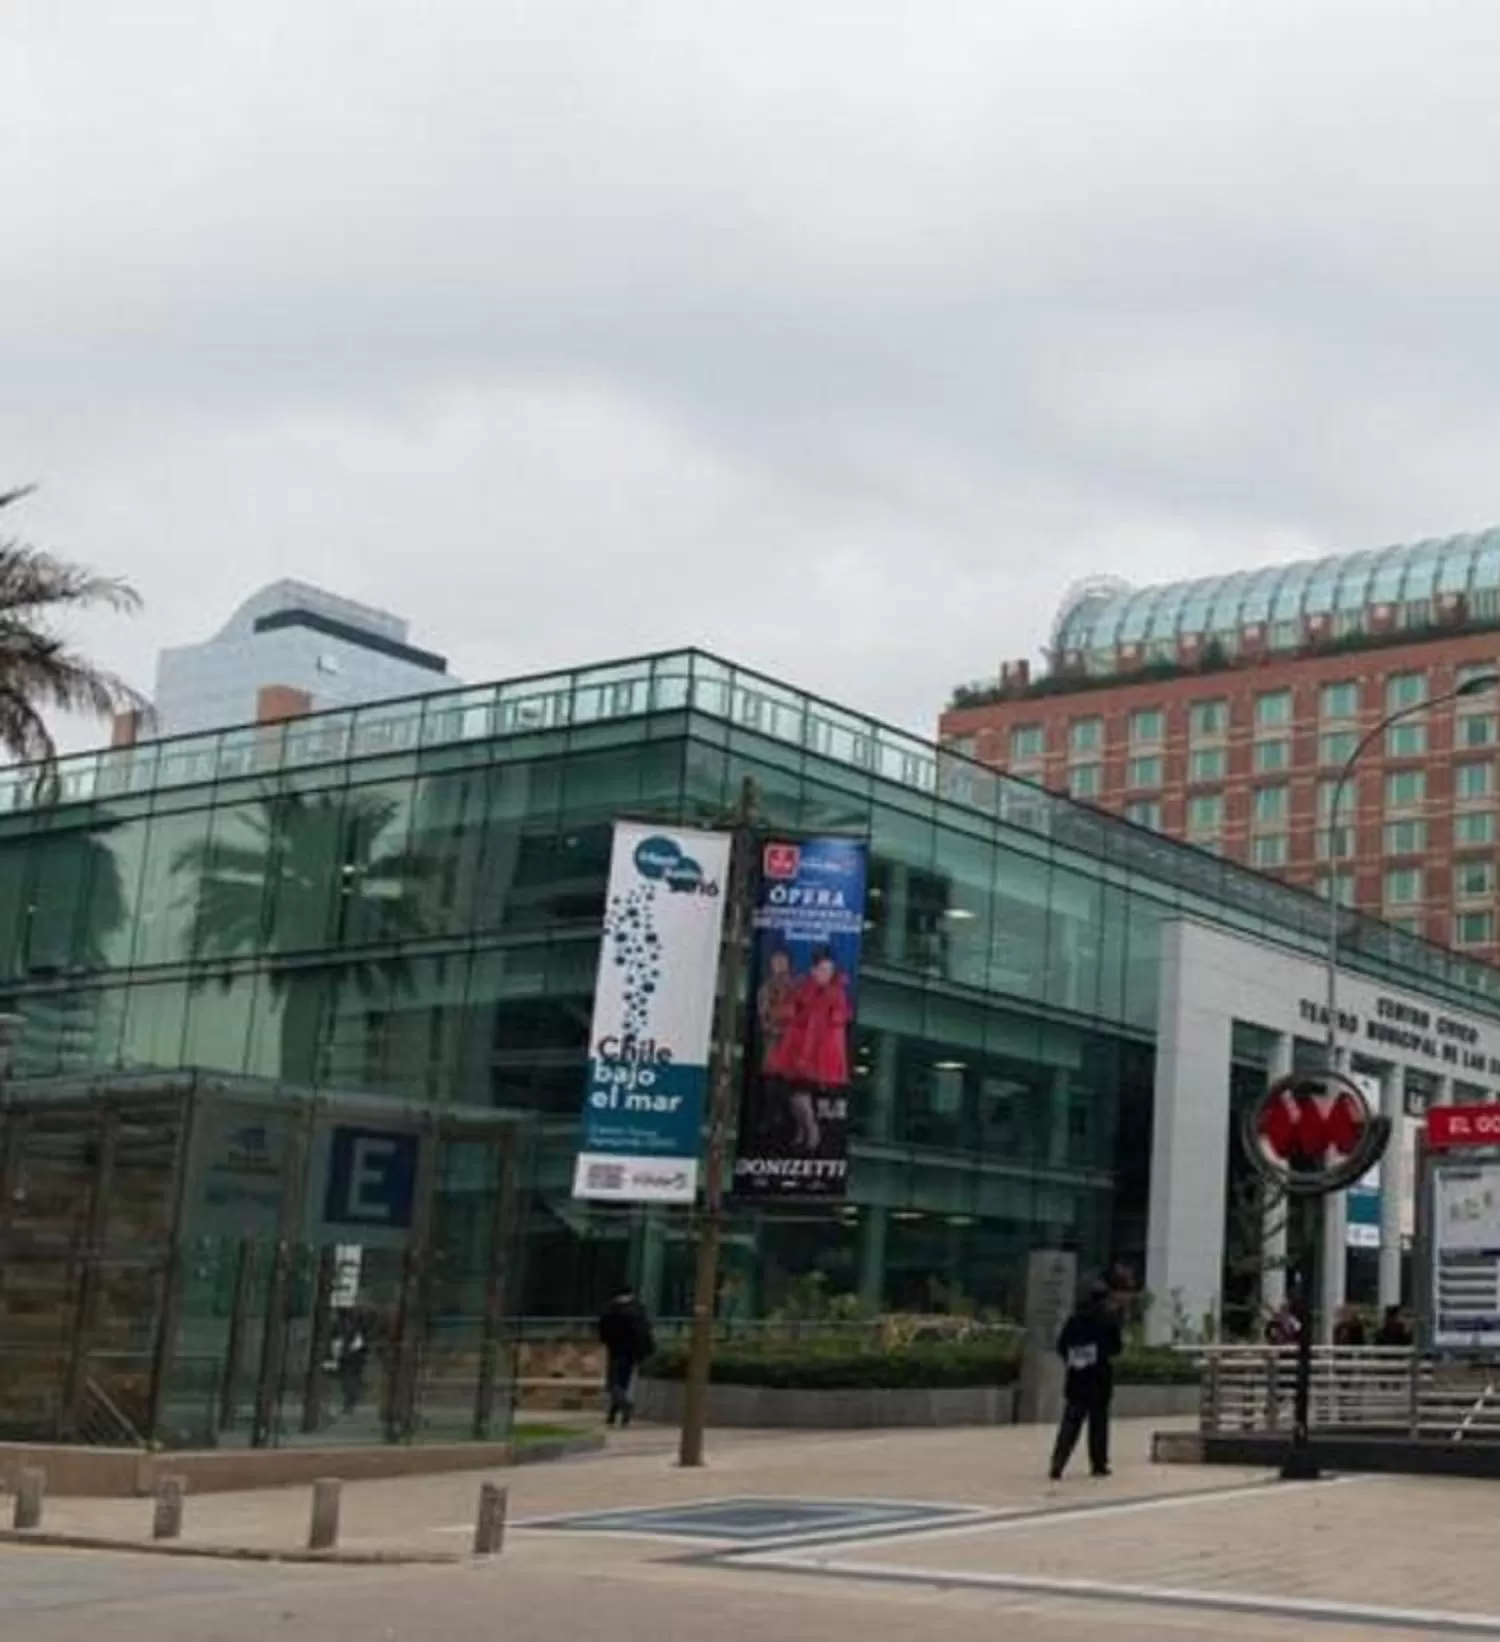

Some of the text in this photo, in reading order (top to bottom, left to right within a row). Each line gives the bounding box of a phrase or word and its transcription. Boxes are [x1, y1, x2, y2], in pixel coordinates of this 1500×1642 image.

[598, 1034, 673, 1065] Chile
[593, 1059, 657, 1090] bajo
[591, 1084, 684, 1112] el mar
[1448, 1115, 1472, 1135] EL
[348, 1137, 397, 1218] E
[735, 1158, 848, 1177] DONIZETTI
